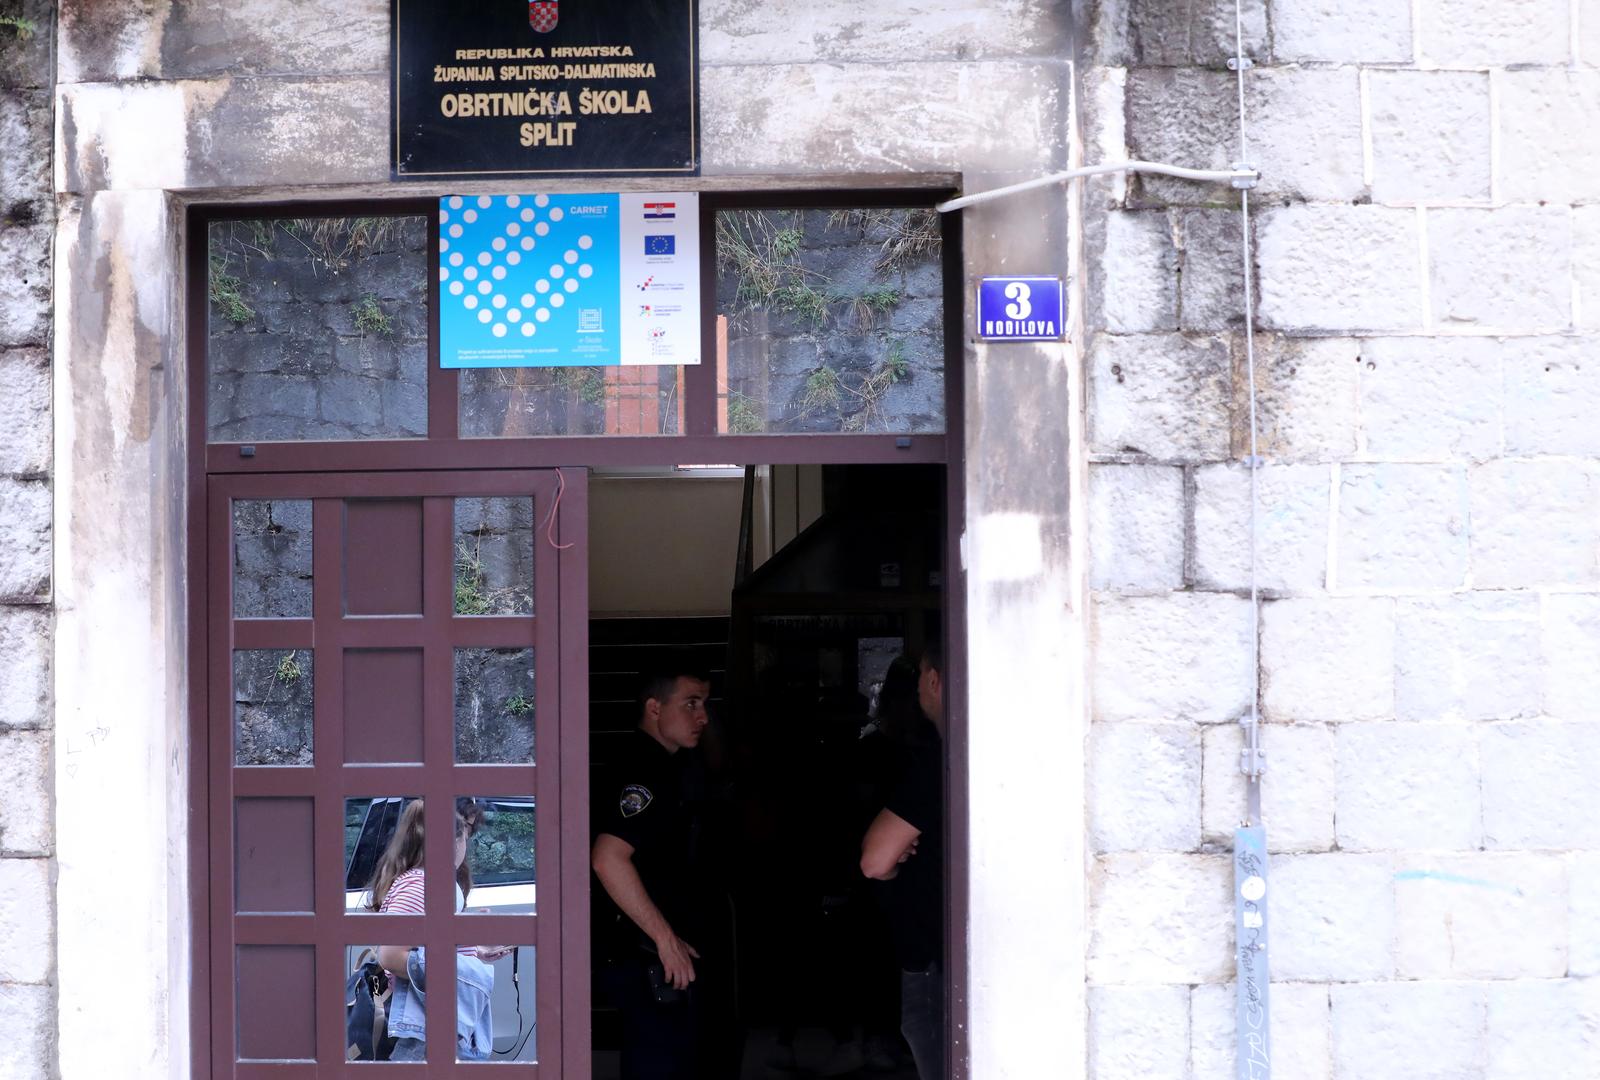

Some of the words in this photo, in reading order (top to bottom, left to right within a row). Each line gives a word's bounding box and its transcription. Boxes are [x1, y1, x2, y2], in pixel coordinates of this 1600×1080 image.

[456, 48, 544, 59] REPUBLIKA
[551, 46, 633, 57] HRVATSKA
[434, 65, 495, 82] ŽUPANIJA
[500, 63, 656, 80] SPLITSKO-DALMATINSKA
[441, 88, 572, 117] OBRTNIČKA
[579, 87, 652, 114] ŠKOLA
[520, 122, 576, 146] SPLIT
[570, 206, 608, 215] CARNET
[1004, 281, 1032, 320] 3
[986, 320, 1055, 336] NODILOVA
